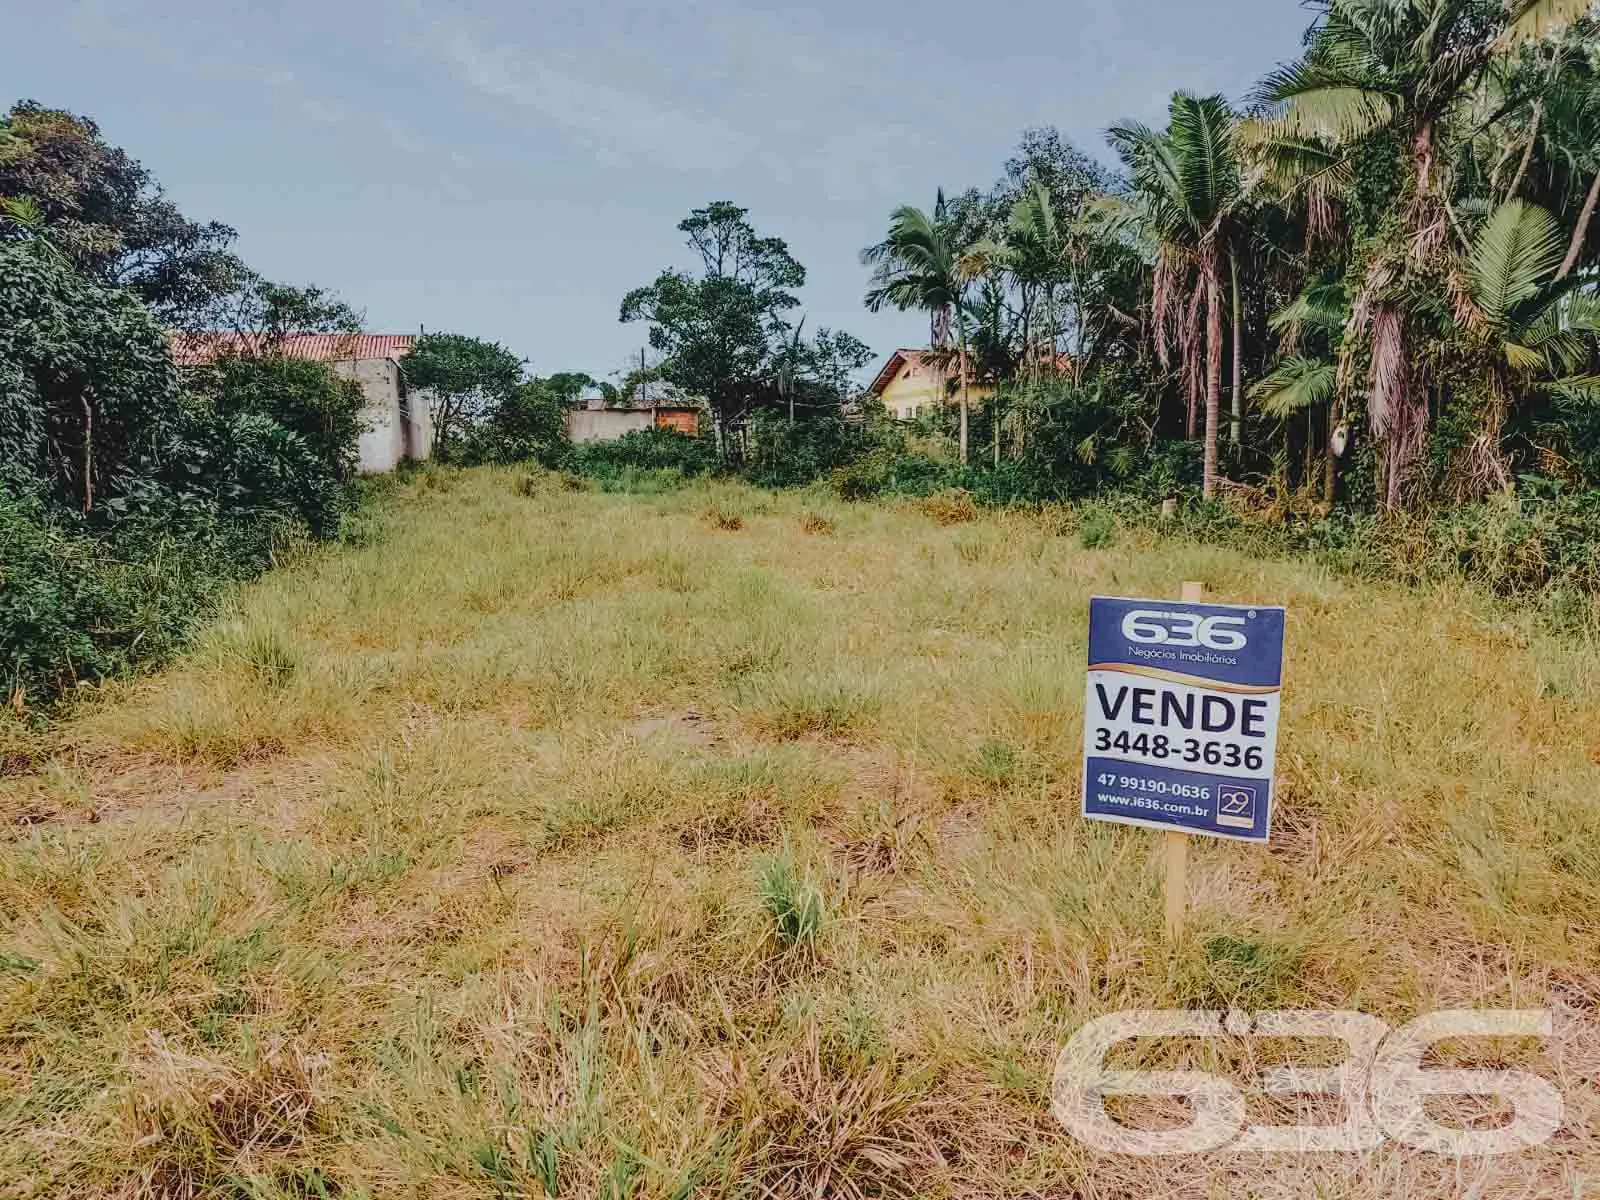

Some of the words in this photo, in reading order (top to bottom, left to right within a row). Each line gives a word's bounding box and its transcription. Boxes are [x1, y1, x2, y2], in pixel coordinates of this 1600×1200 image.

[1128, 646, 1176, 660] Negócios
[1179, 651, 1238, 665] Imobiliários
[1095, 684, 1268, 738] VENDE
[1095, 727, 1263, 770] 3448-3636
[1097, 773, 1116, 787] 47
[1119, 776, 1210, 800] 99190-0636
[1097, 792, 1209, 817] www.i636.com.br
